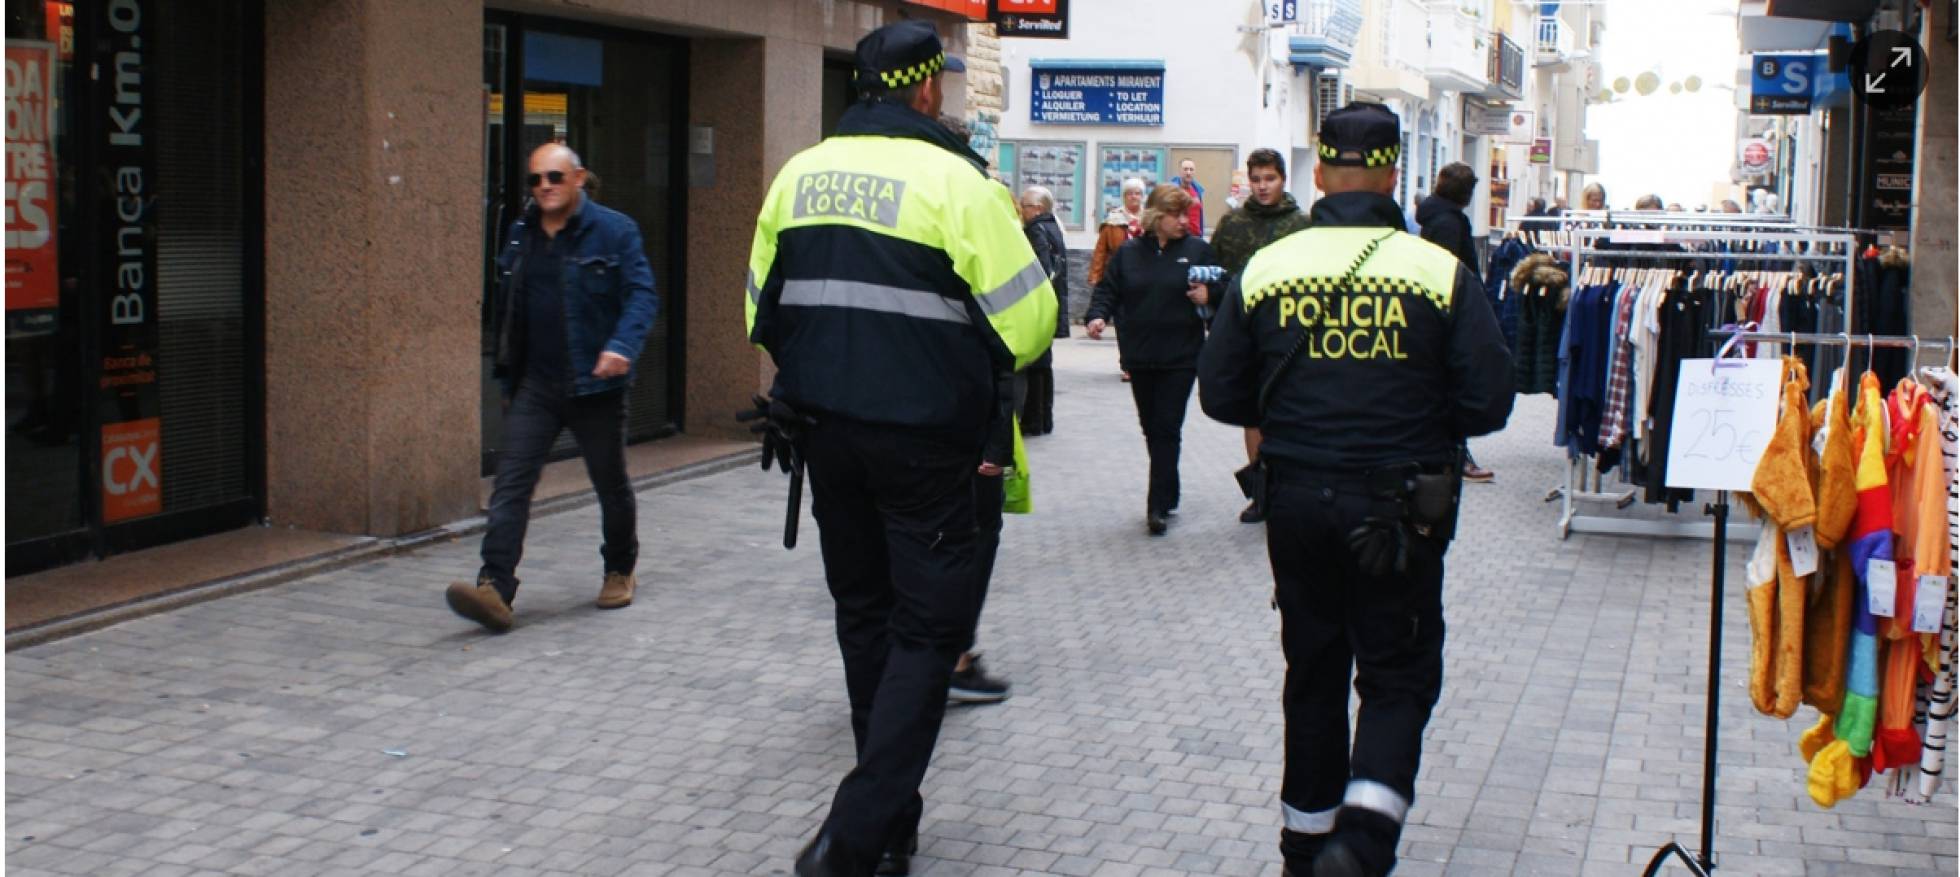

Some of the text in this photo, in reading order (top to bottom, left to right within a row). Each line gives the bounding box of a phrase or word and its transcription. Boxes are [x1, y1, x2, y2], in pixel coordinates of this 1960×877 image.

[1054, 75, 1161, 89] APARTAMENTS MIRAVENT
[1782, 61, 1808, 95] S
[1042, 91, 1083, 100] LLOGUER
[1042, 101, 1085, 111] ALQUILER
[1116, 103, 1160, 113] LOCATION
[1117, 92, 1148, 102] TO LET
[1042, 112, 1100, 122] VERMIETUNG
[1116, 113, 1160, 123] VERHUUR
[801, 173, 896, 202] POLICIA
[806, 193, 880, 220] LOCAL
[112, 166, 144, 325] Banca
[1279, 295, 1408, 328] POLICIA
[1309, 328, 1409, 359] LOCAL
[1683, 407, 1763, 465] 25€
[103, 442, 159, 497] CX
